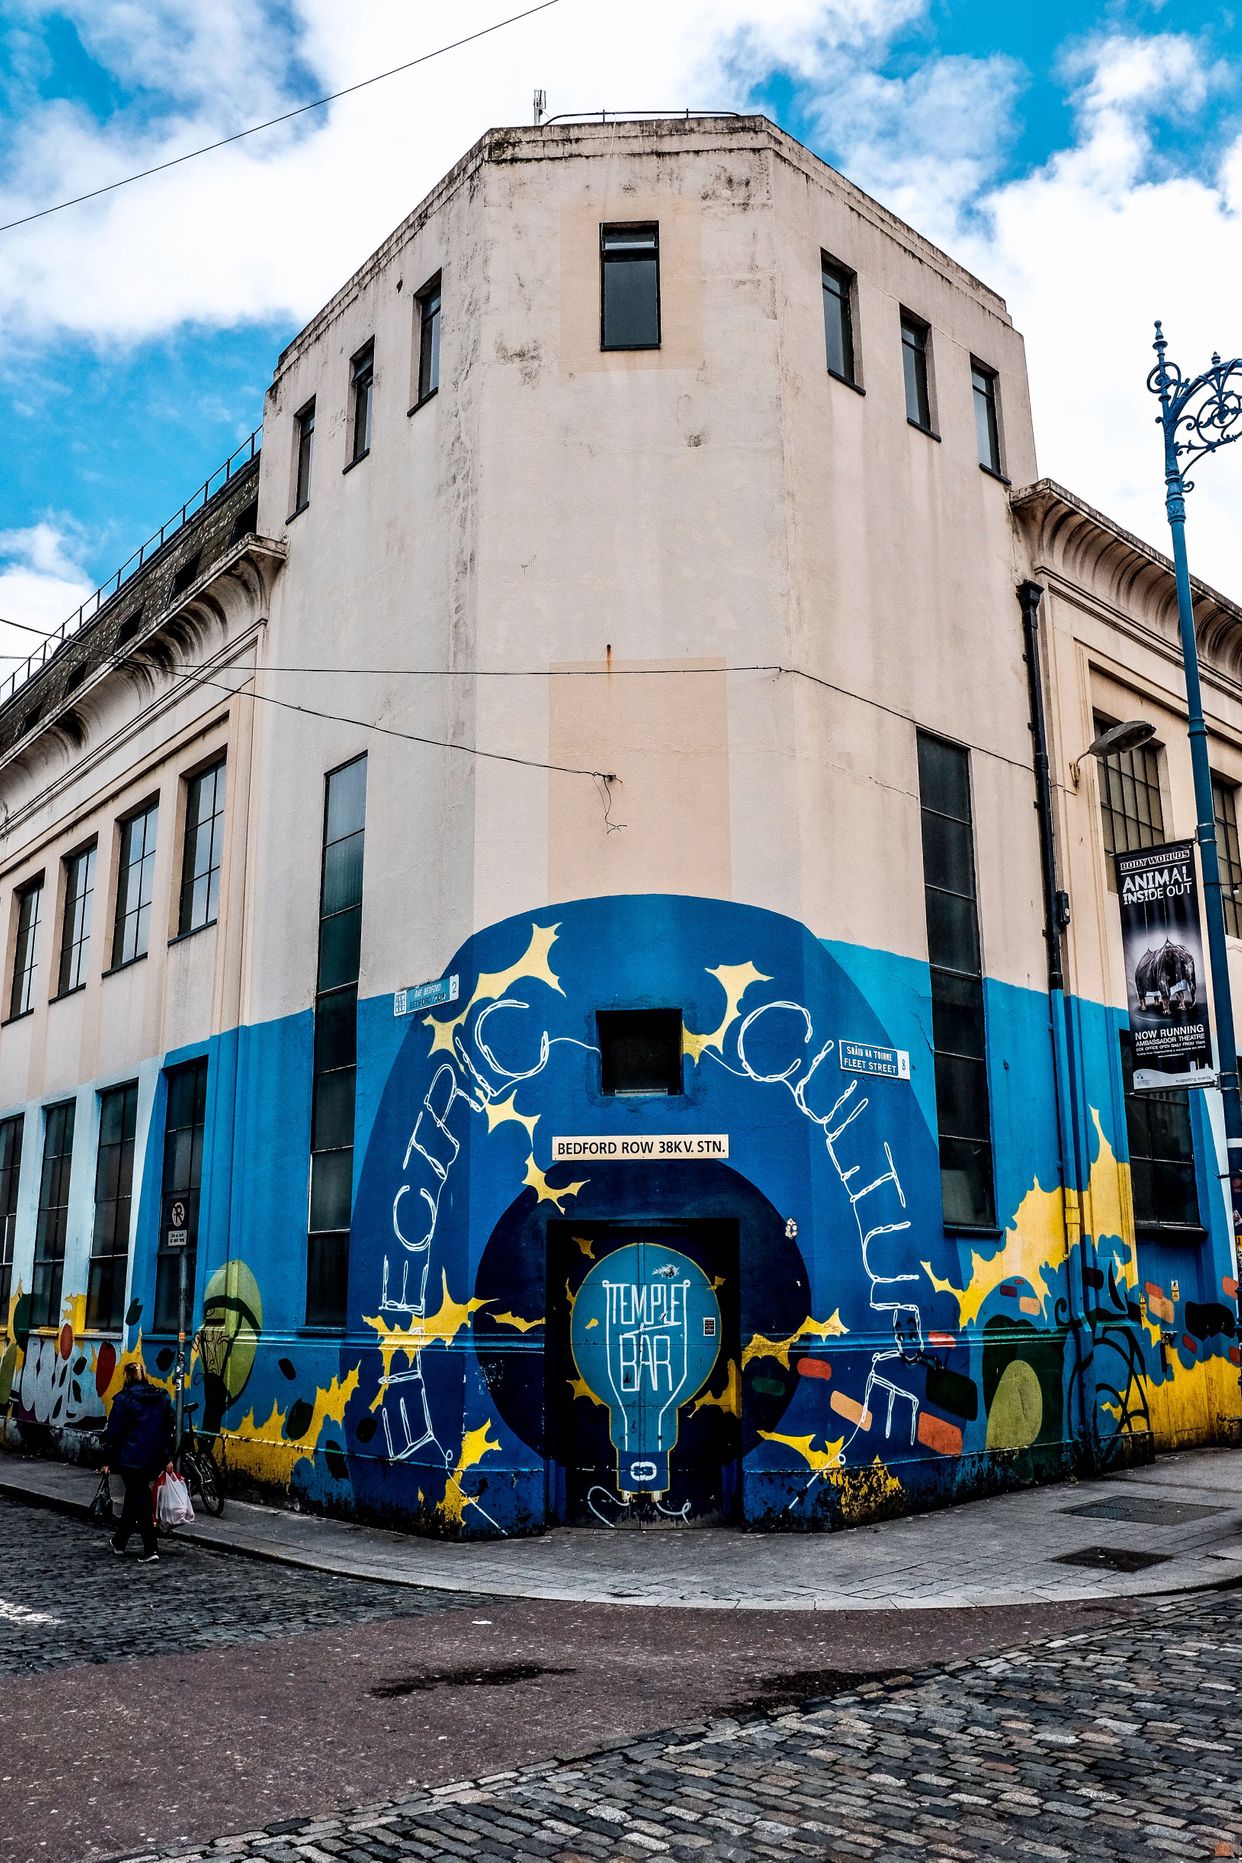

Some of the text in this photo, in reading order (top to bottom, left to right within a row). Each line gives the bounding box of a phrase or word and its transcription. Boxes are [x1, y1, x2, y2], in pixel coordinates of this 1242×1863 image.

[1122, 865, 1192, 893] ANIMAL
[1123, 882, 1192, 905] INSIDE OUT
[451, 981, 457, 994] 2
[1134, 1024, 1204, 1041] NOW RUNNING
[1135, 1032, 1206, 1047] AMBASSADOR THEATRE
[843, 1057, 907, 1074] FLEET STREET 8
[557, 1140, 726, 1155] BEDFORD ROW 38KV. STN.
[379, 999, 549, 1461] ELECTRIC
[605, 1282, 683, 1325] TEMPLE
[619, 1334, 673, 1392] BAR
